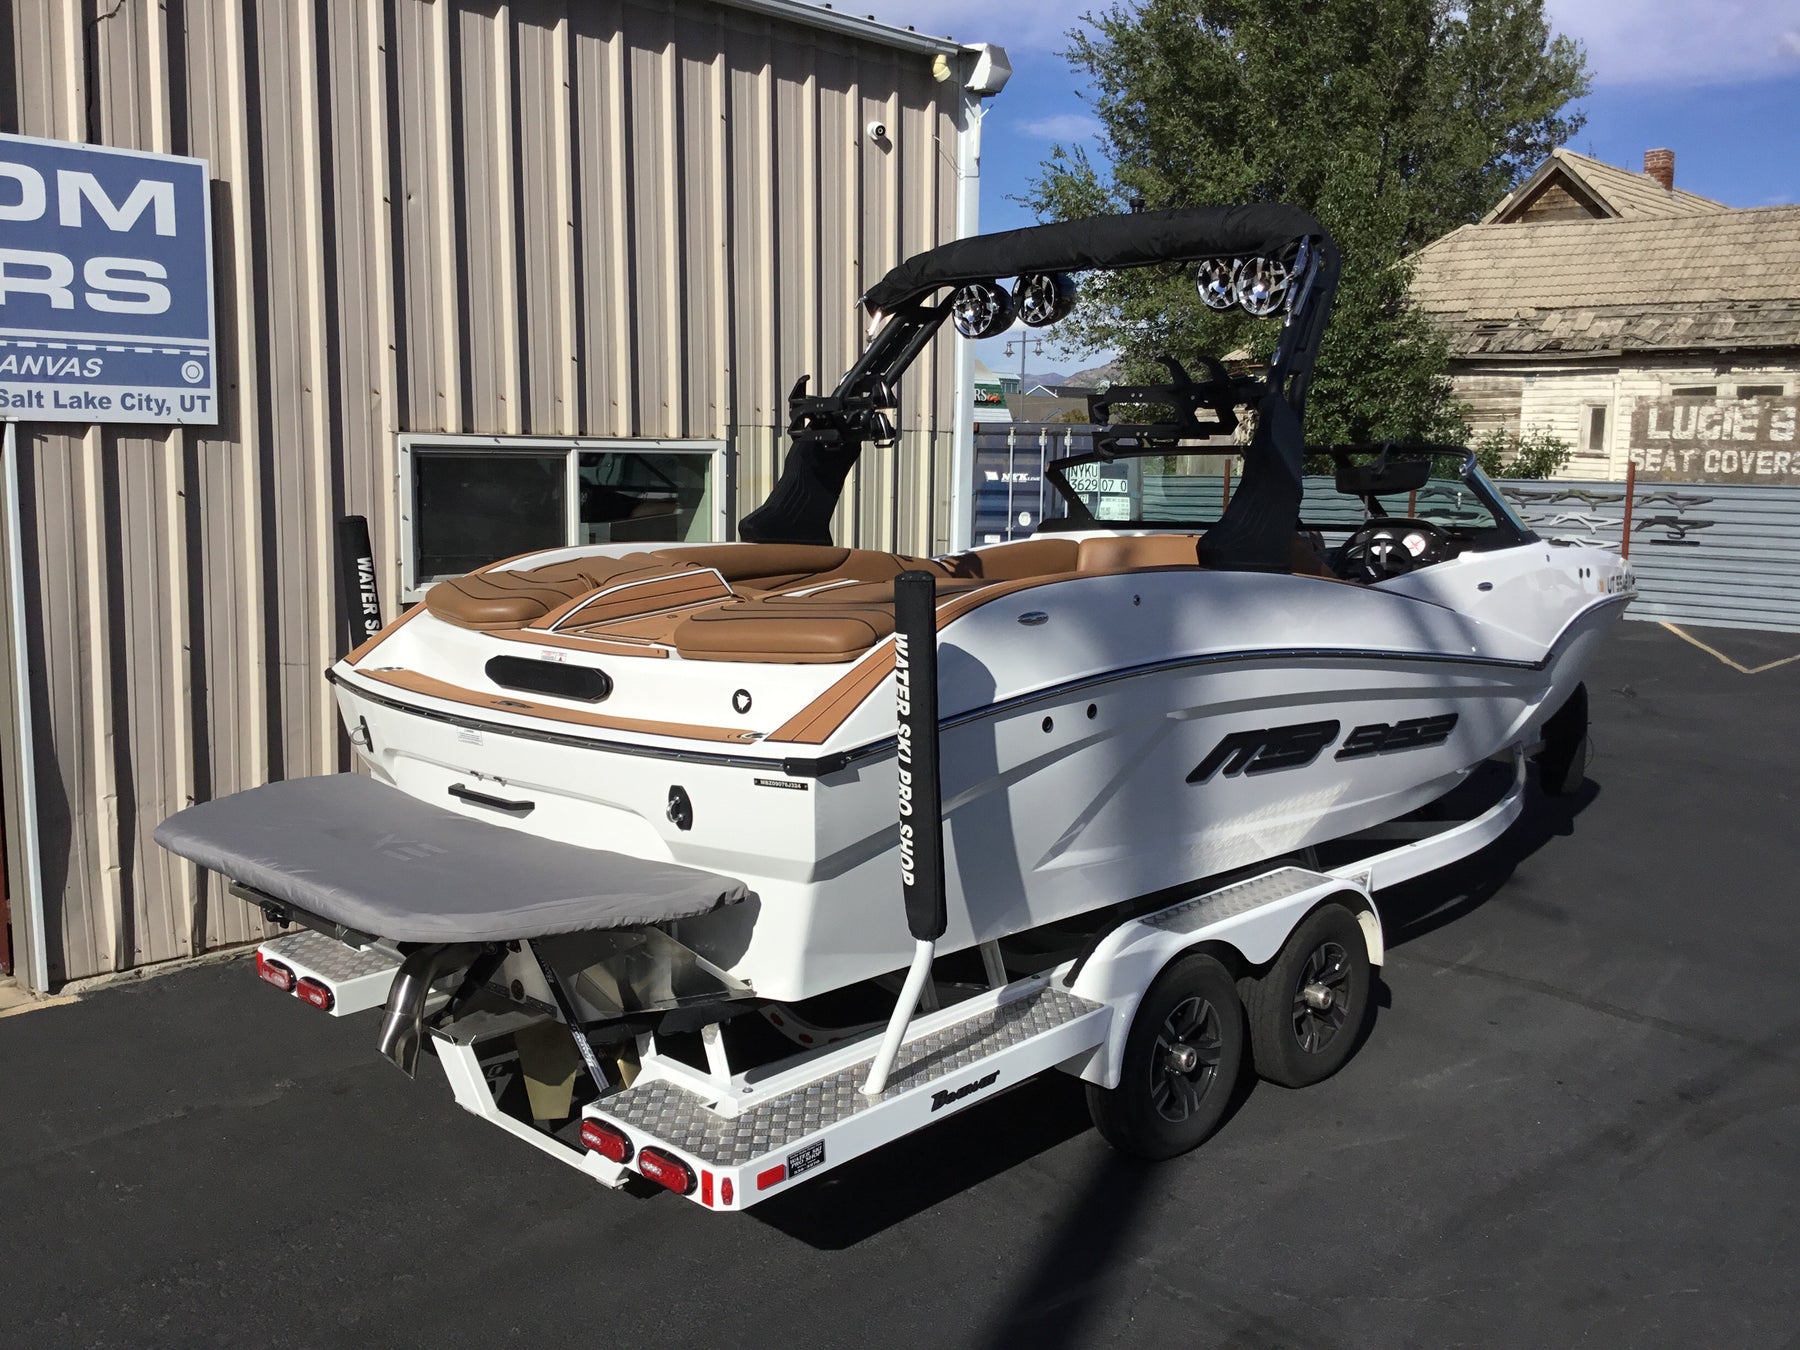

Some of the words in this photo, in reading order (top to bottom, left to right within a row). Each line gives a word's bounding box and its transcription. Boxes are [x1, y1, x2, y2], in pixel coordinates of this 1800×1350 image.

[0, 355, 103, 377] ANVAS
[0, 389, 44, 409] Salt
[54, 390, 112, 410] Lake
[120, 393, 171, 416] City,
[180, 395, 211, 413] UT
[1070, 463, 1098, 478] NYKU
[1629, 448, 1694, 472] SEAT
[1704, 449, 1800, 475] COVERS
[357, 556, 380, 615] WATER
[896, 632, 911, 716] WATER
[897, 720, 912, 764] SKI
[898, 765, 913, 816] PRO
[900, 820, 915, 886] SHOP
